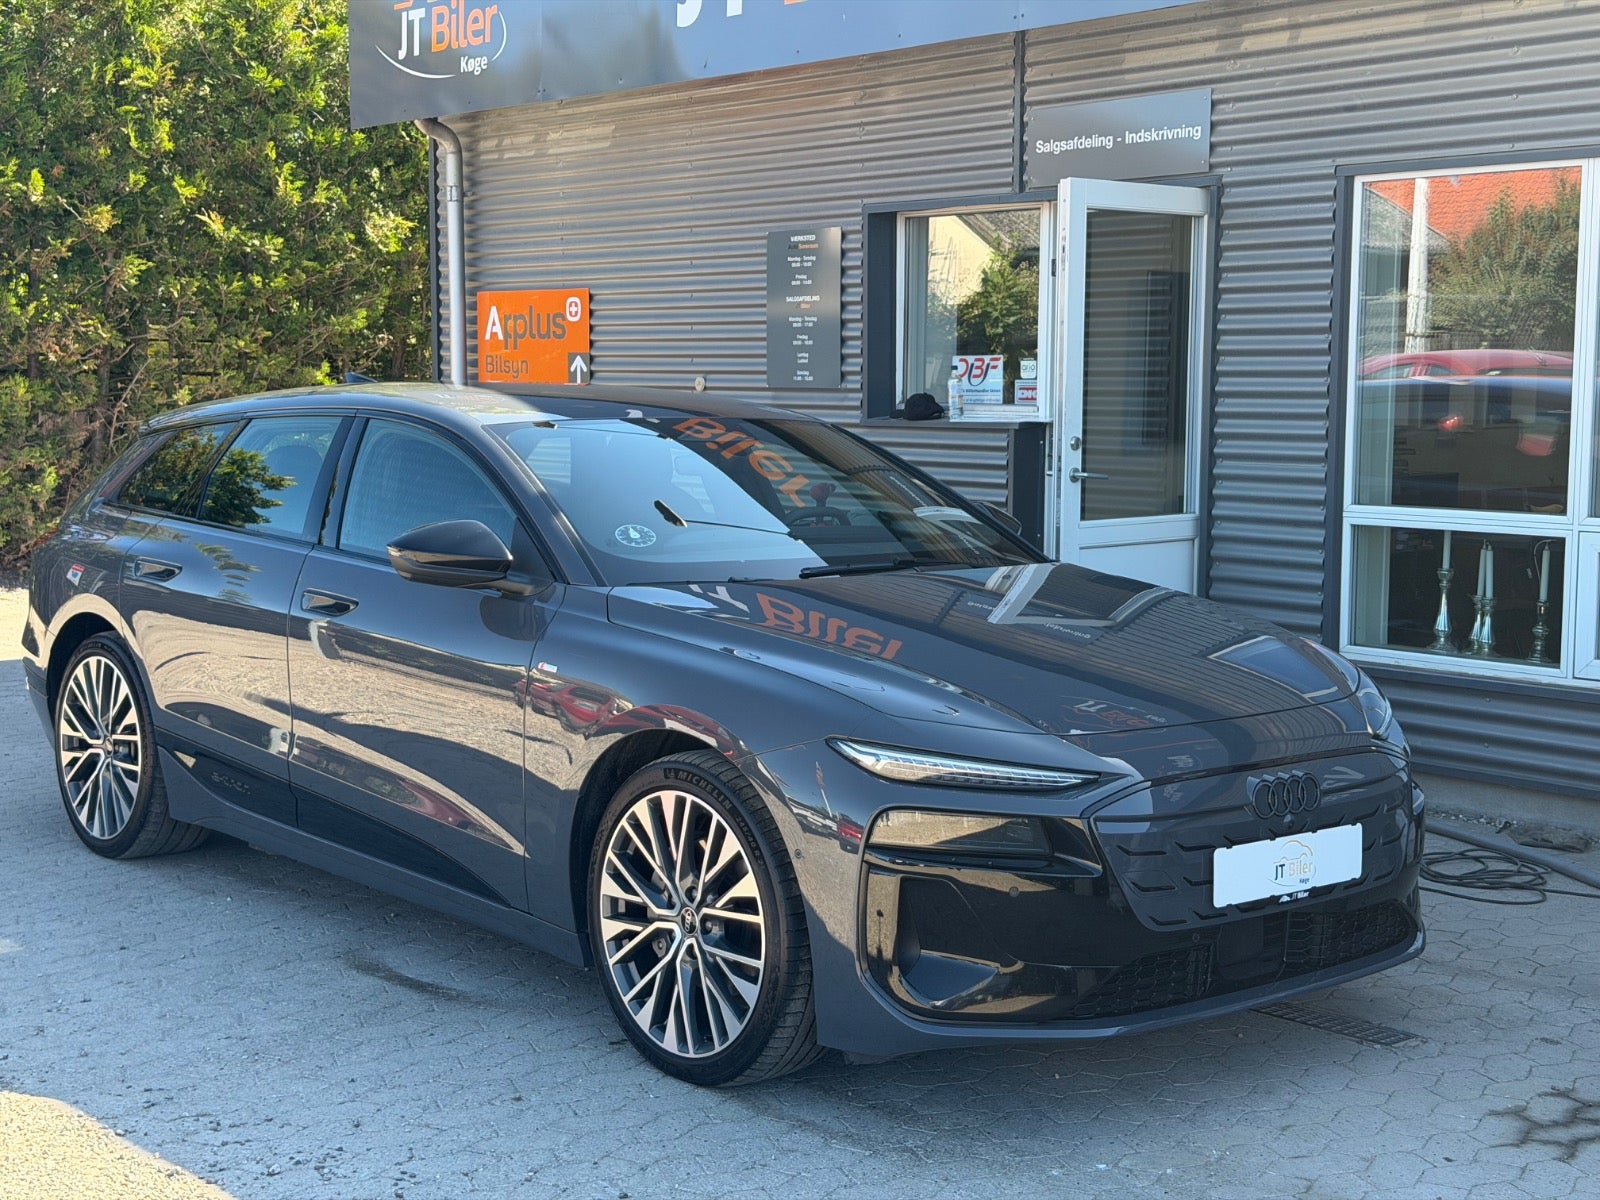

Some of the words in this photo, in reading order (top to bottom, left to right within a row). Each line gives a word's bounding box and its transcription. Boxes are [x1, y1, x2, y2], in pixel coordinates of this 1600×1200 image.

[398, 8, 426, 60] JT
[431, 0, 498, 53] Biler
[460, 55, 488, 76] Køge
[1035, 135, 1114, 155] Salgsafdeling
[1125, 124, 1202, 145] Indskrivning
[485, 355, 529, 379] Bilsyn
[677, 770, 732, 810] MICHELIN
[1275, 864, 1286, 881] JT
[1288, 860, 1313, 877] Biler
